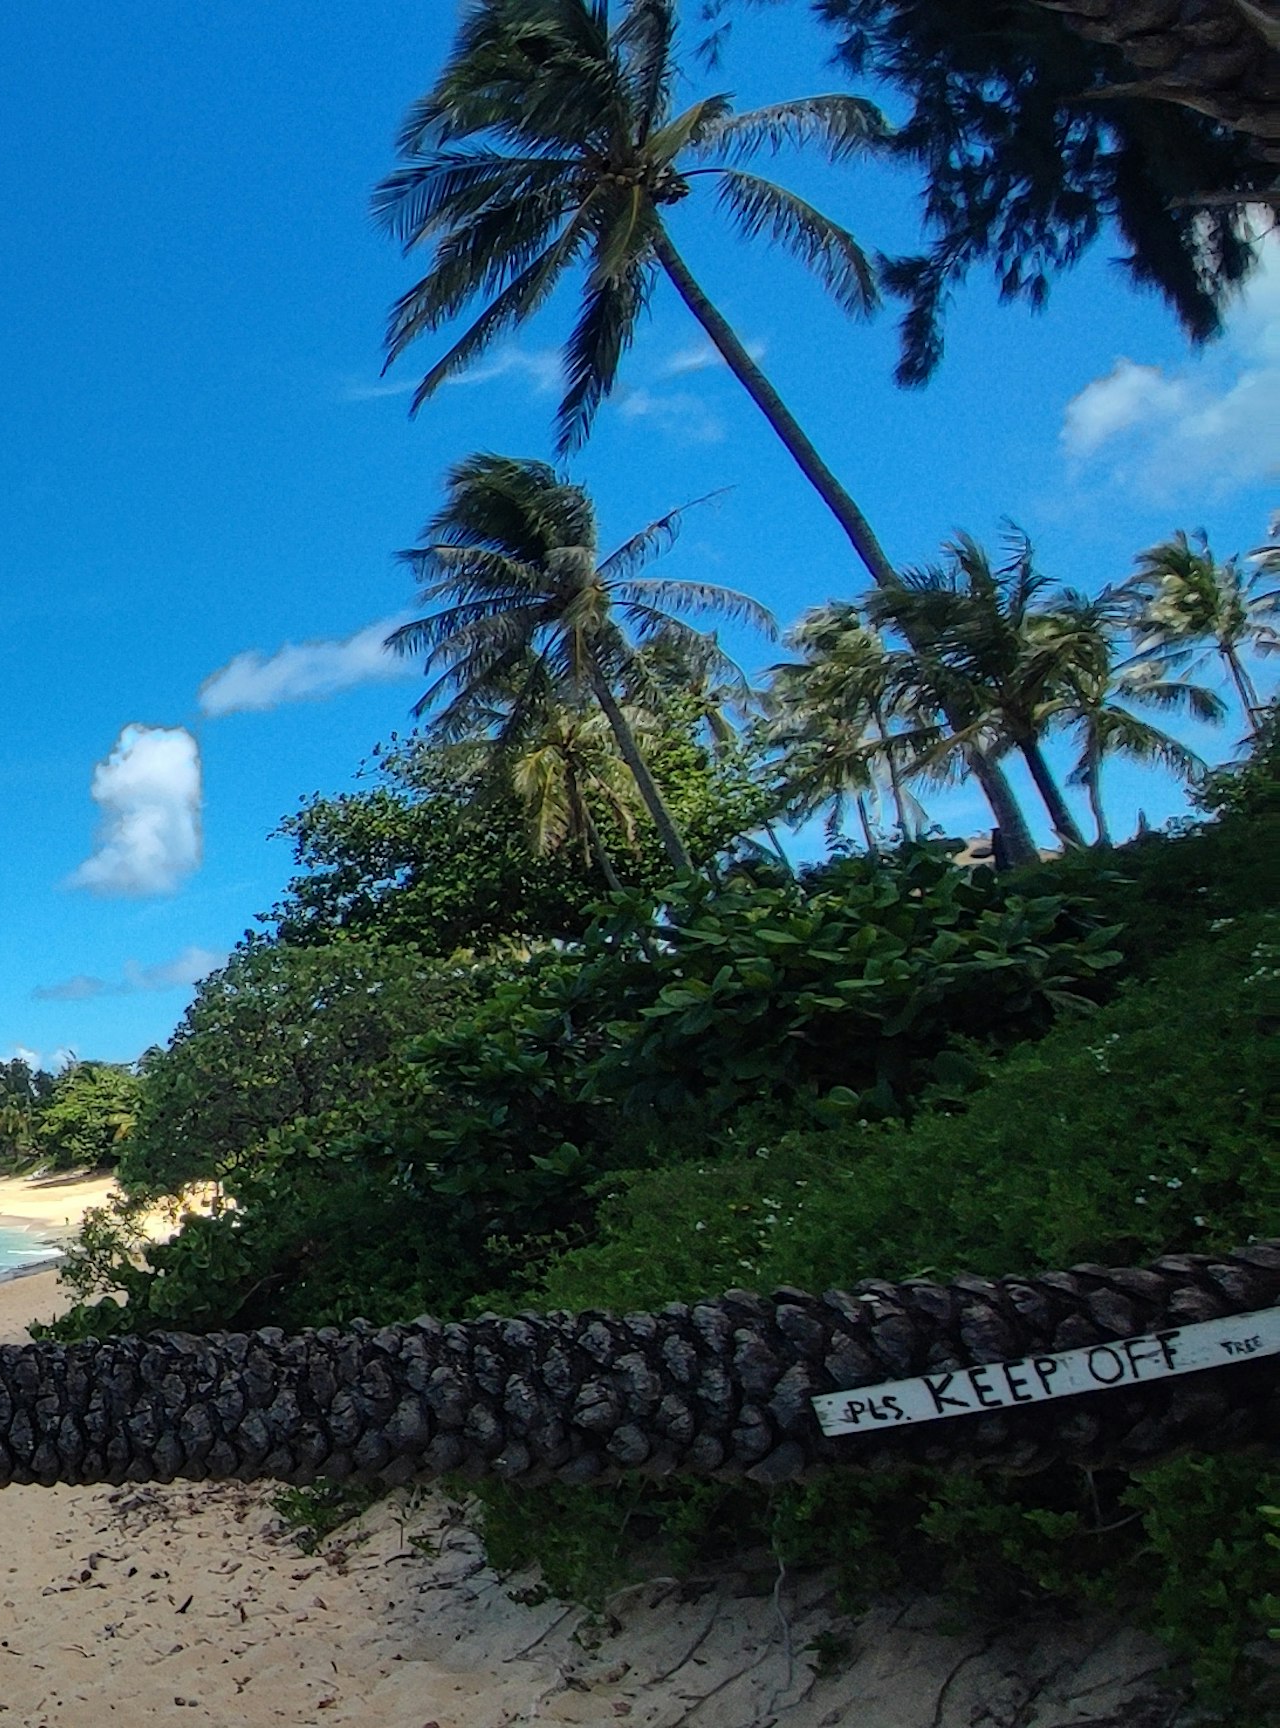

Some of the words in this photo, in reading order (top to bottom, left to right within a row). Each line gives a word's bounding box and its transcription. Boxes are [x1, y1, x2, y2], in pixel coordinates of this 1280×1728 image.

[924, 1358, 1058, 1414] KEEP
[1088, 1331, 1181, 1384] OFF
[1219, 1335, 1264, 1356] TREE
